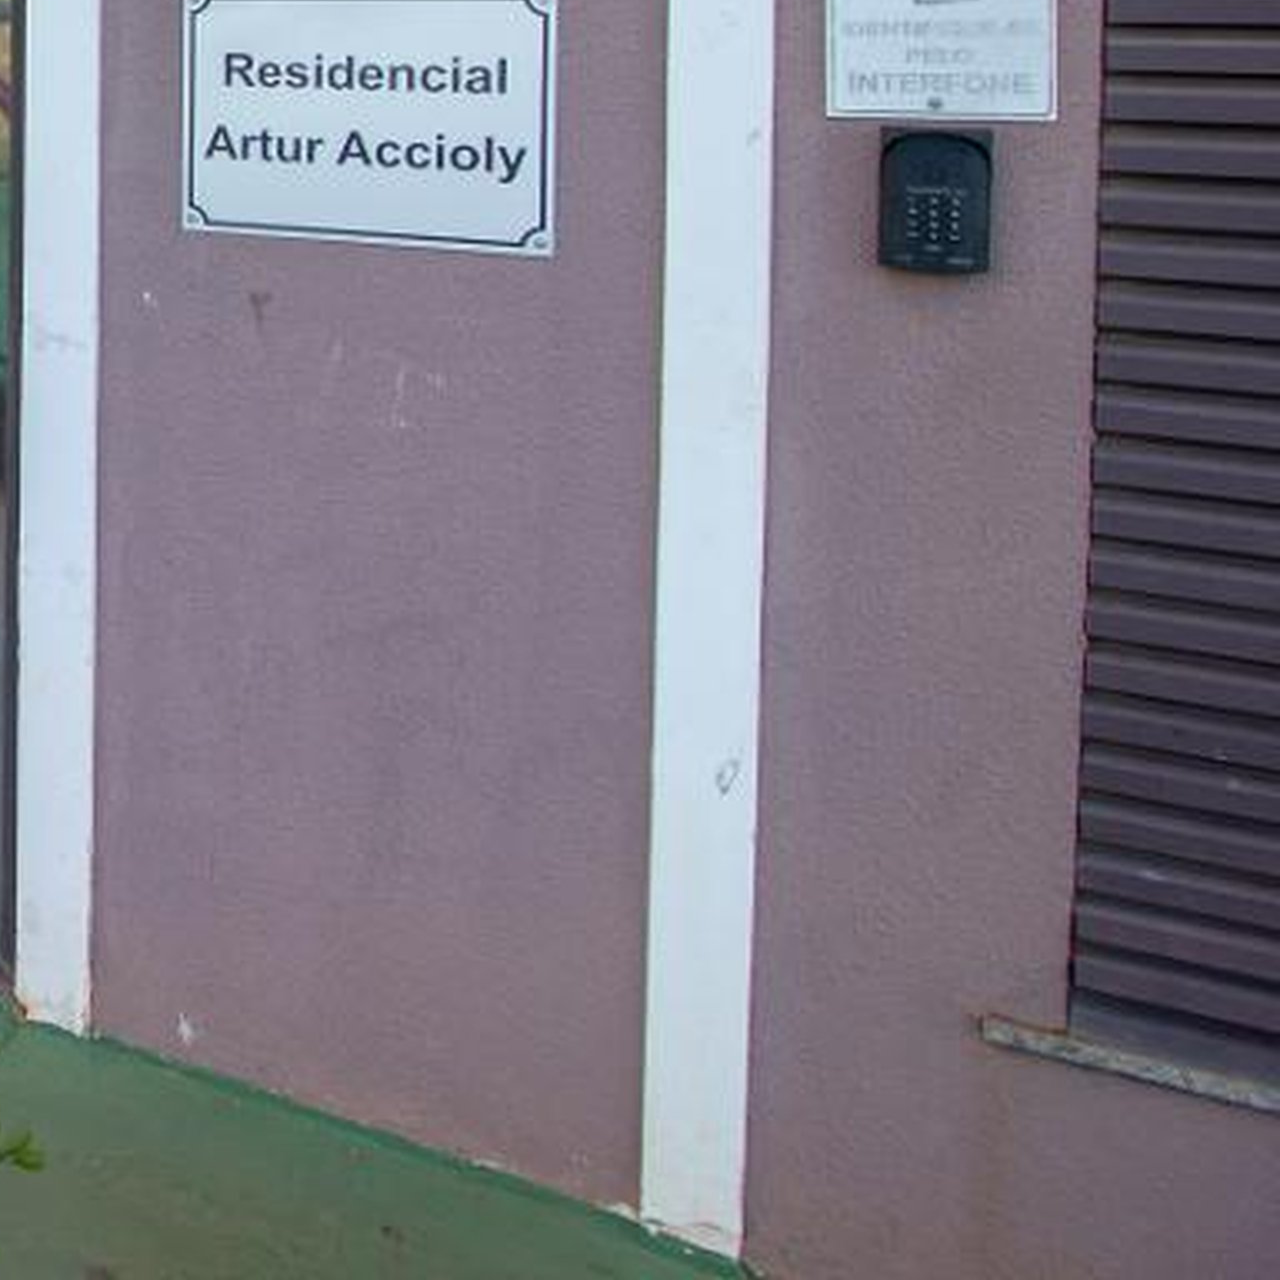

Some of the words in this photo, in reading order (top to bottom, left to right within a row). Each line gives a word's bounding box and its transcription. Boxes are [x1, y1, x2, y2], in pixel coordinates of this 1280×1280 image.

[223, 52, 508, 94] Residencial
[848, 73, 1040, 95] INTERFONE
[204, 124, 323, 165] Artur
[336, 129, 527, 184] Accioly
